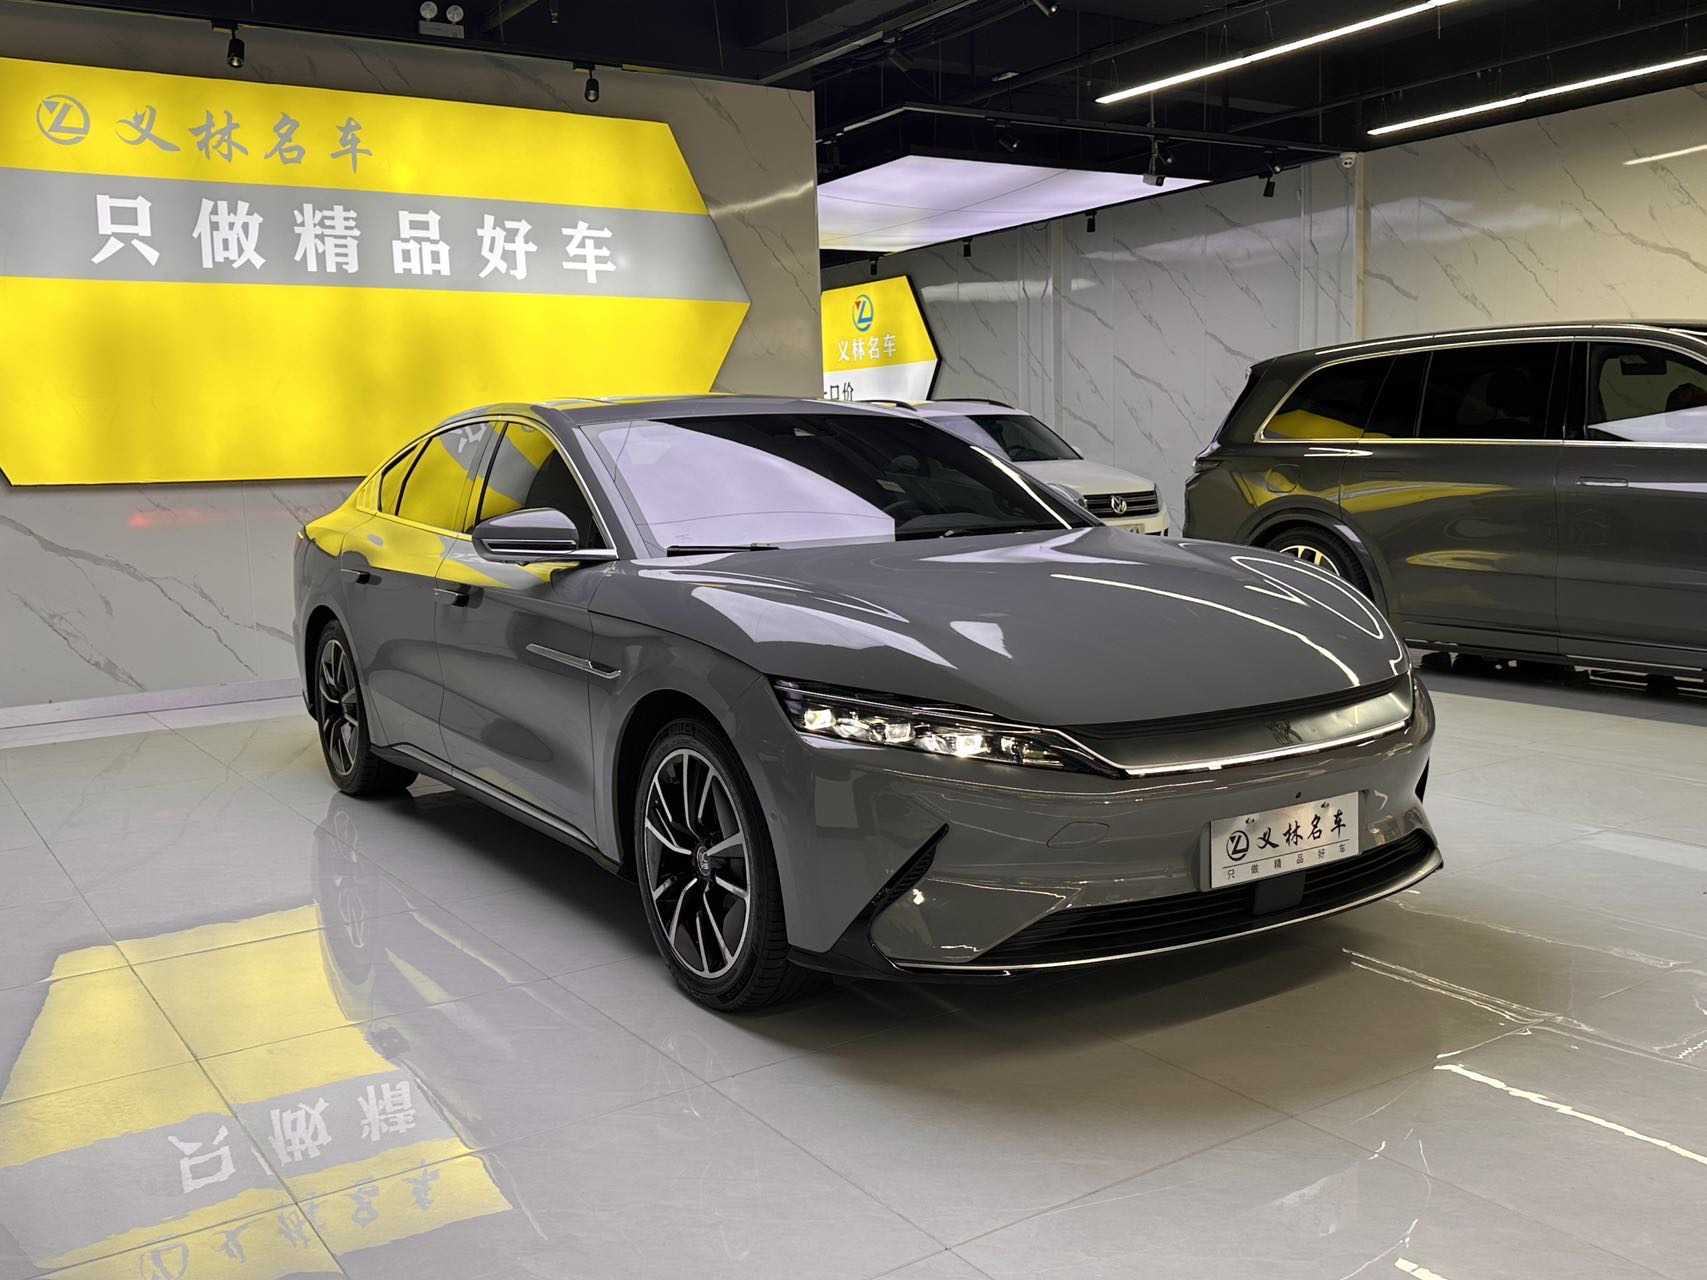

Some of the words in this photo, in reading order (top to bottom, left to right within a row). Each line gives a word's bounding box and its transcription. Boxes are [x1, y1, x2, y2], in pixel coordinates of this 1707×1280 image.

[115, 105, 373, 174] 义林名车
[91, 193, 618, 284] 只做精品好车
[838, 334, 896, 362] 义林名车
[823, 381, 854, 400] 口价
[1256, 809, 1346, 850] 义林名车
[1227, 844, 1346, 880] 只做精品好车
